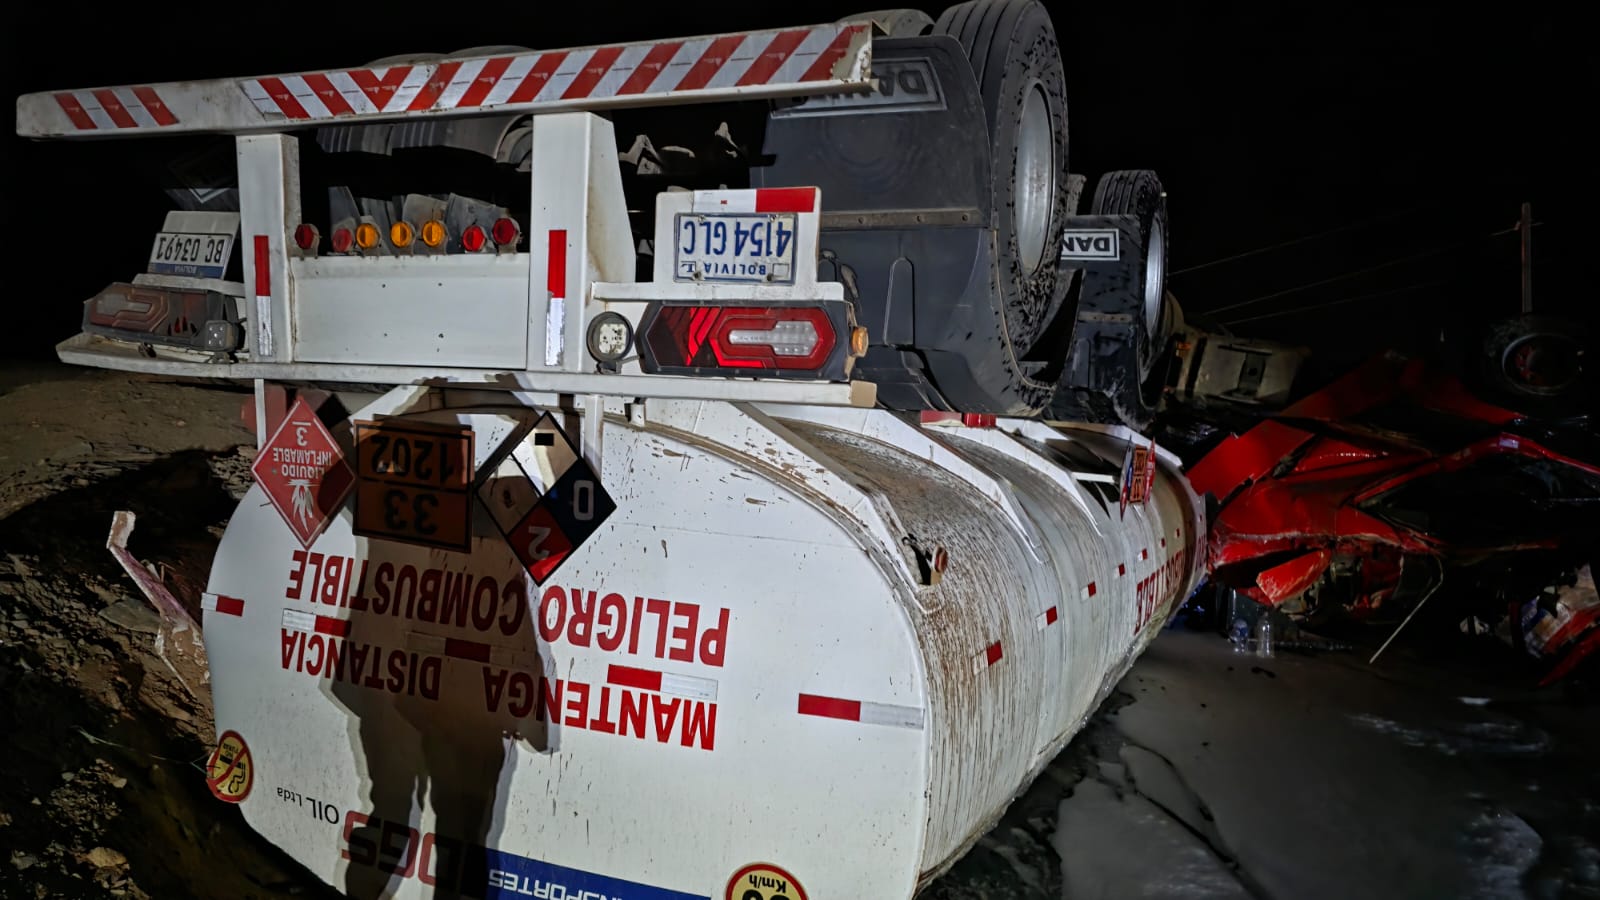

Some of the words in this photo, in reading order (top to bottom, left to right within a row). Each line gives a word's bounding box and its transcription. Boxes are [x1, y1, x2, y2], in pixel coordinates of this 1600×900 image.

[157, 236, 200, 262] 03491
[205, 239, 225, 263] BC
[683, 221, 727, 255] GLC
[735, 221, 792, 257] 4154
[704, 262, 767, 275] BOLIVIA
[296, 427, 308, 446] 3
[272, 447, 332, 467] INFLAMABLE
[281, 463, 326, 480] LIQUIDO
[371, 434, 454, 484] 1202
[384, 489, 439, 535] 33
[572, 480, 595, 521] 0
[527, 525, 551, 560] 2
[286, 550, 526, 635] COMBUSTIBLE
[538, 585, 730, 667] PELIGRO
[281, 628, 442, 700] DISTANCIA
[483, 666, 717, 751] MANTENGA
[277, 787, 302, 807] Ltda
[306, 797, 340, 824] OIL
[749, 874, 786, 893] Km/h
